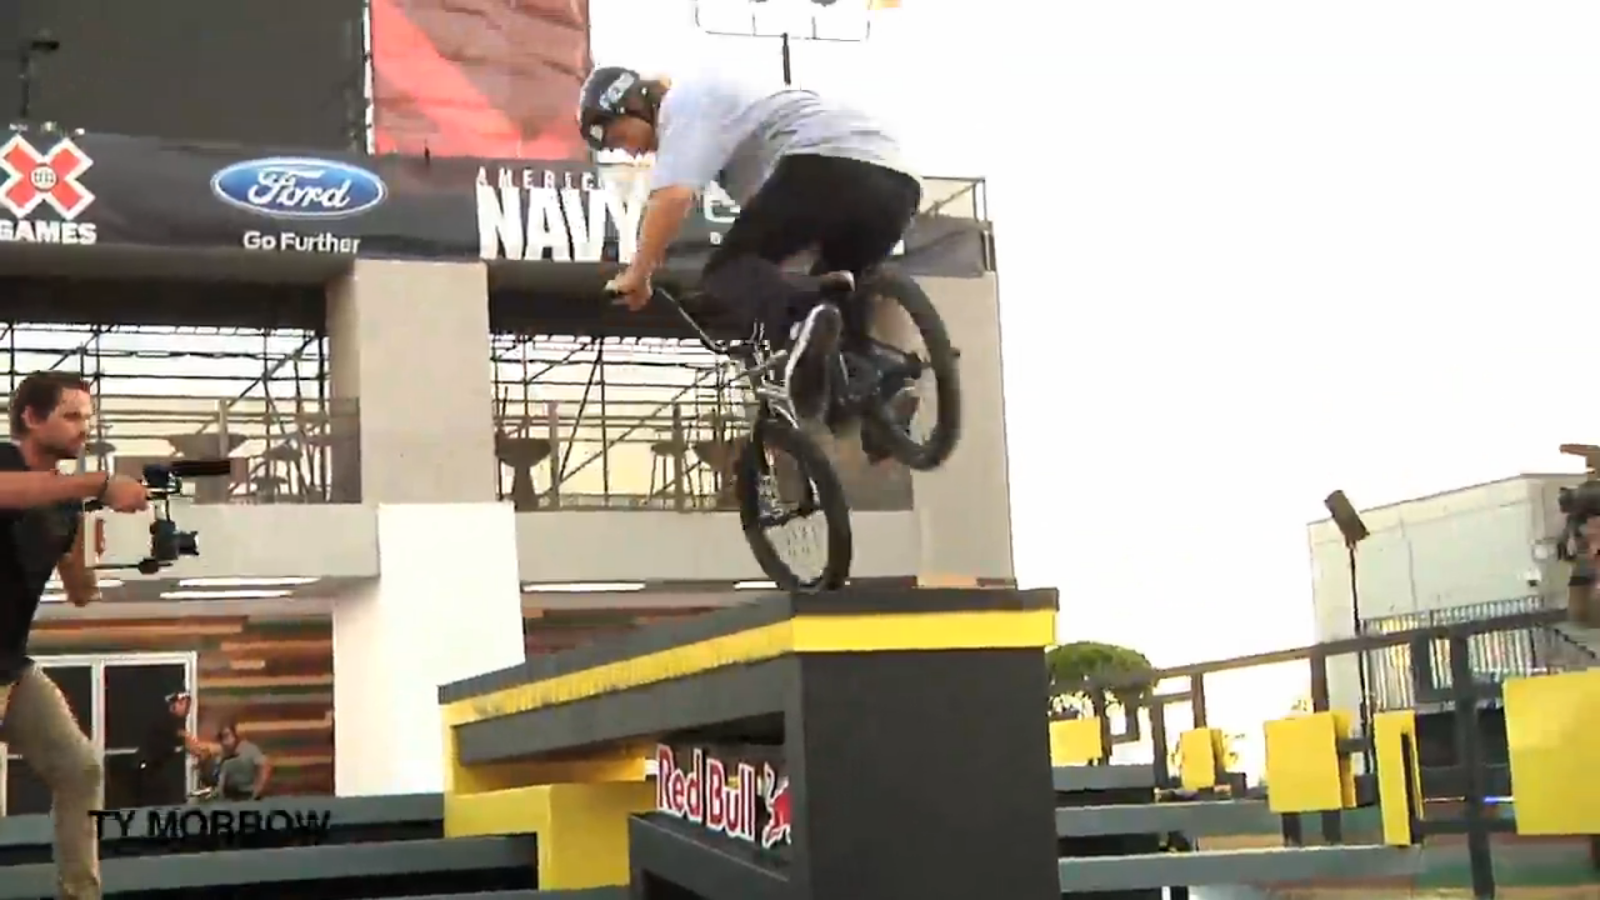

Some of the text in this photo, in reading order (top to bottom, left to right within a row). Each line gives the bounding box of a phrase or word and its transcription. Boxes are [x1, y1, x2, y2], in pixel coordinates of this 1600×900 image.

[247, 167, 352, 207] Ford
[476, 166, 606, 191] AMERIC
[0, 219, 97, 245] GAMES
[476, 184, 648, 264] NAVY
[243, 230, 361, 254] Go Further
[656, 743, 756, 842] Red Bull
